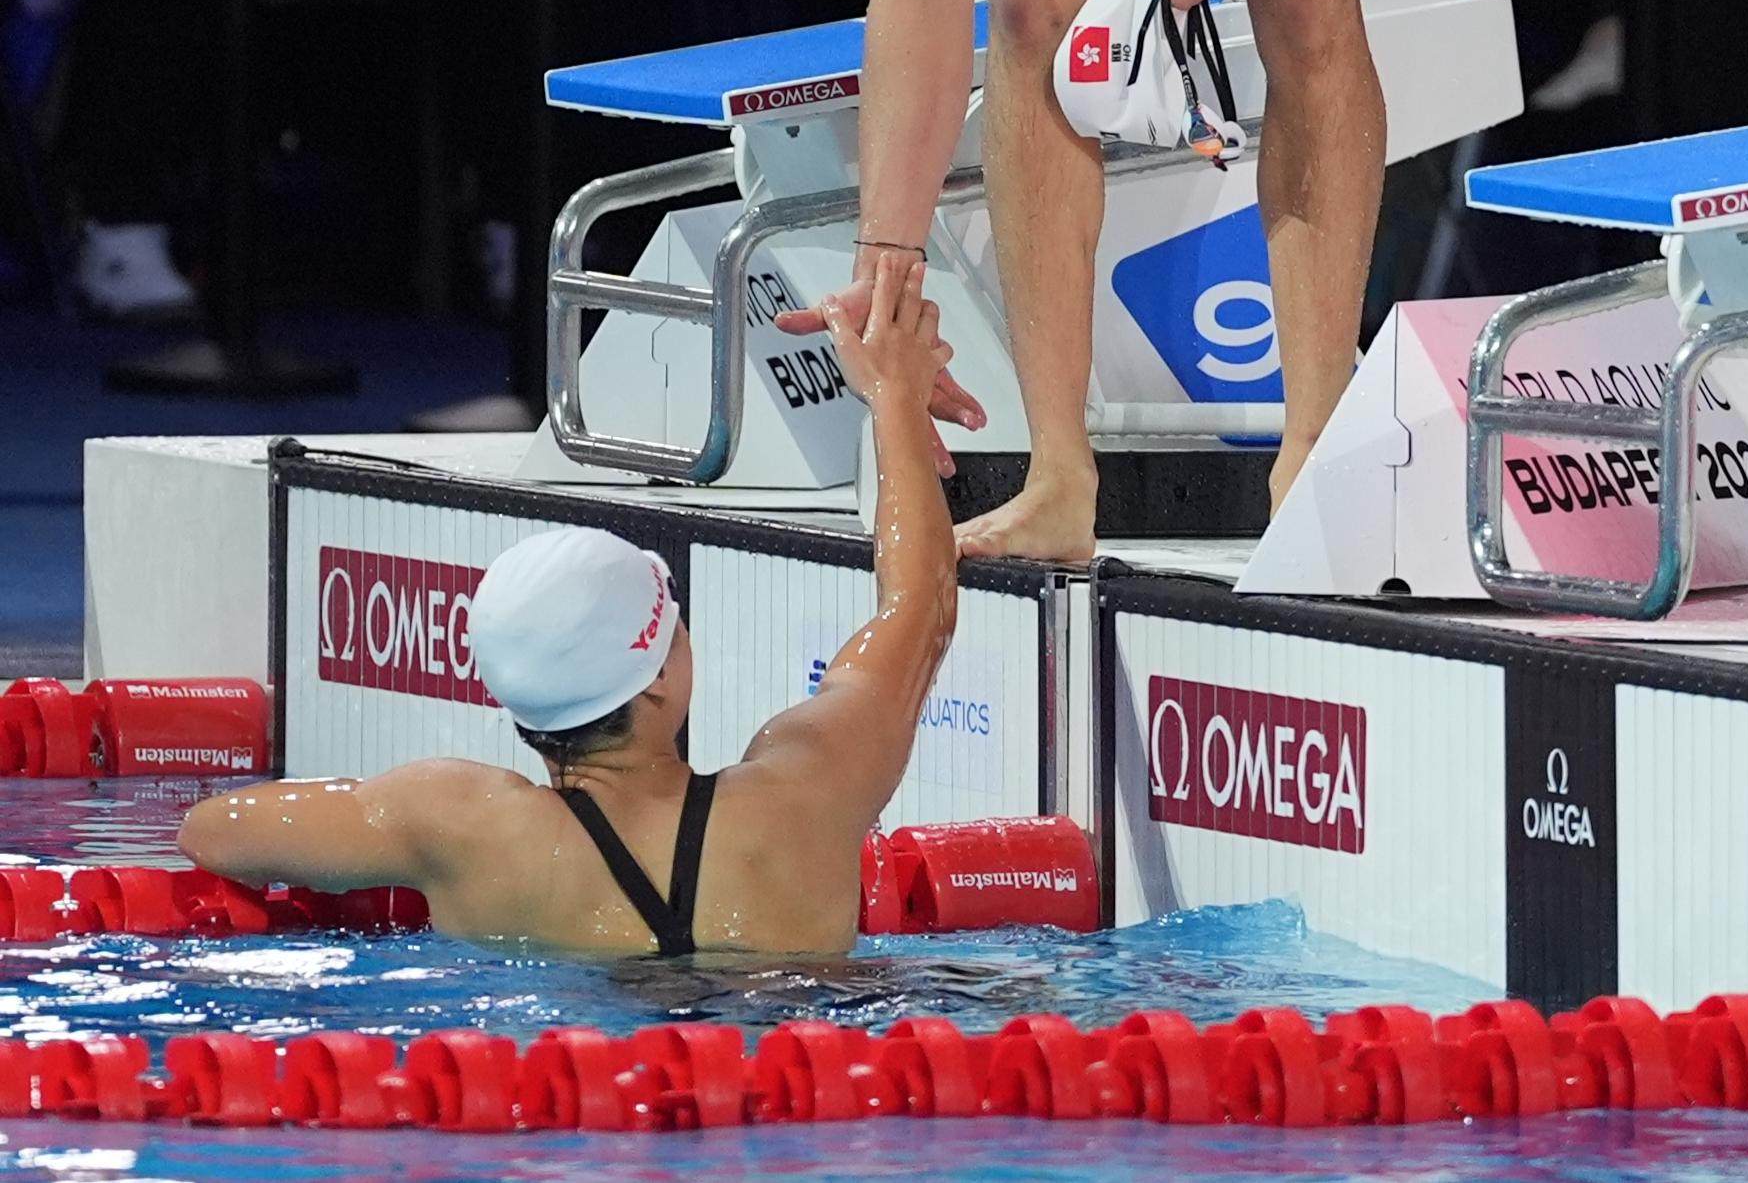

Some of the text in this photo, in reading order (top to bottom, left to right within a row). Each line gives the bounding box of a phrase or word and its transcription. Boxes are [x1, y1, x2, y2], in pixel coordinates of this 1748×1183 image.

[1112, 43, 1121, 63] HKG
[1123, 44, 1131, 62] HO
[769, 81, 846, 107] OMEGA
[1193, 280, 1284, 382] 9
[366, 580, 483, 681] OMEG
[152, 686, 249, 699] Malmsten
[134, 747, 229, 767] Malmsten
[1202, 714, 1363, 829] OMEGA
[1522, 798, 1596, 848] OMEGA
[949, 871, 1052, 891] Malmsten
